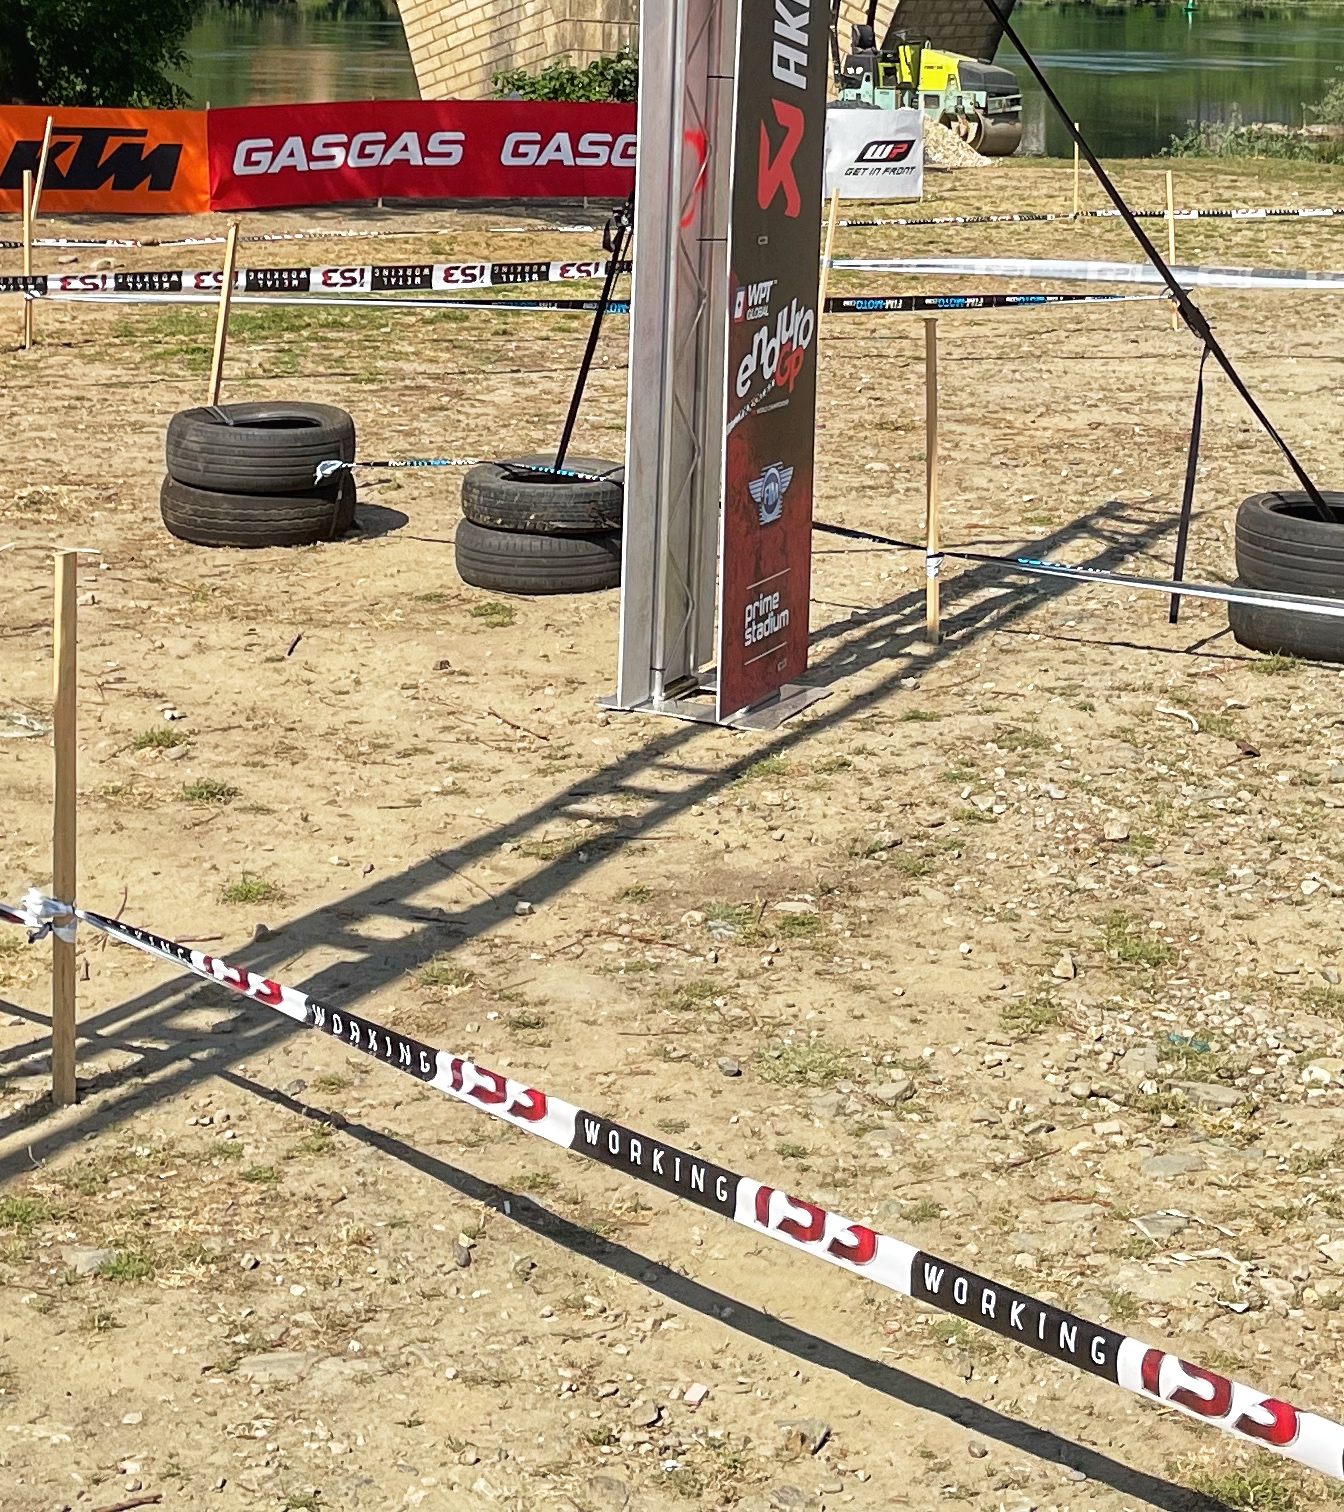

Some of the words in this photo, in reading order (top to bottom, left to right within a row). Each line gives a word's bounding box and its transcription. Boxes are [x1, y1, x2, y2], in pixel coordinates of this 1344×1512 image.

[232, 131, 465, 176] GASGAS
[500, 131, 637, 167] GASG
[844, 167, 868, 176] GET
[869, 167, 881, 176] IN
[882, 166, 916, 176] FRONT
[862, 142, 909, 160] WP
[746, 305, 769, 321] GLOBAL
[747, 280, 774, 307] WPT
[735, 297, 815, 399] enduro
[774, 340, 805, 394] GP
[744, 608, 790, 647] stadium
[745, 591, 780, 630] prime
[312, 1003, 432, 1075] WORKING
[583, 1118, 729, 1202] WORKING
[923, 1262, 1108, 1366] WORKING
